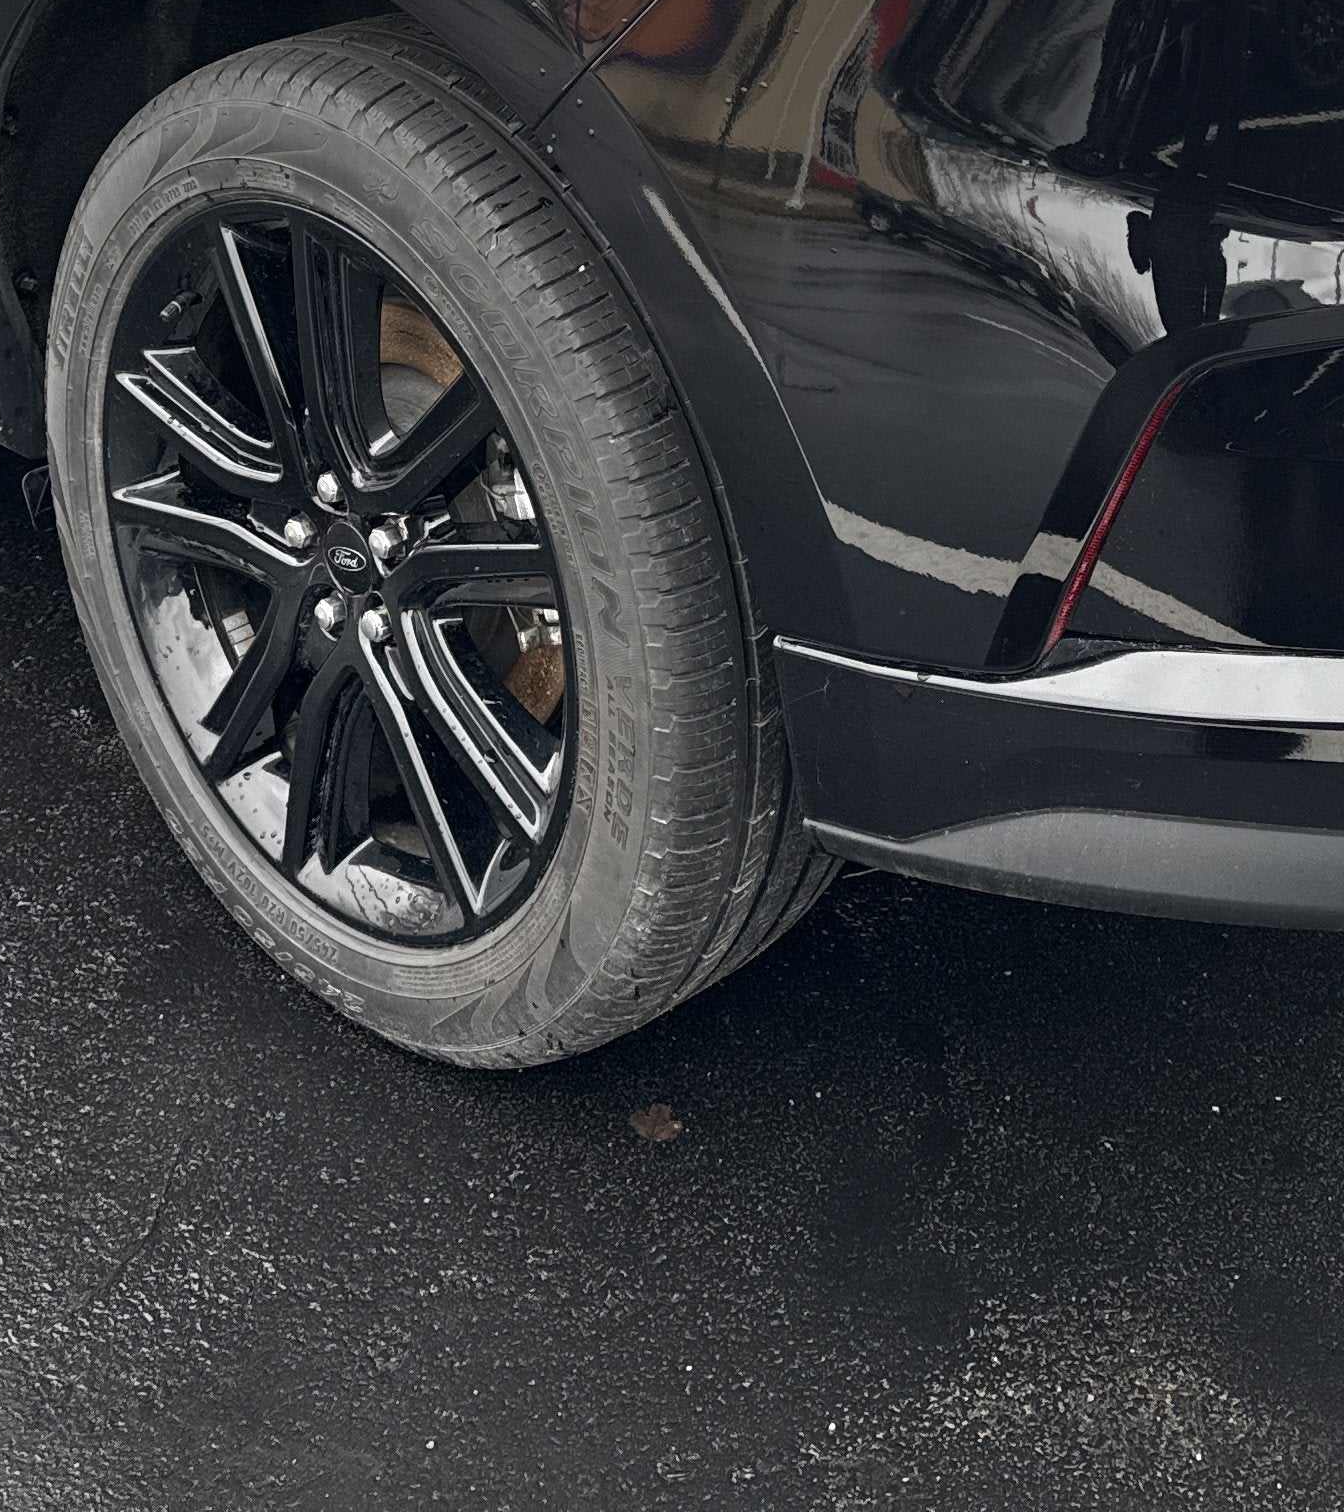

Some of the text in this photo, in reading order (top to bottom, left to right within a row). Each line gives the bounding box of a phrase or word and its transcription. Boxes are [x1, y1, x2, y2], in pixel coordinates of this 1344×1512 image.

[408, 216, 631, 649] SCORPION
[332, 548, 361, 569] Ford
[611, 675, 636, 851] VERDE
[227, 860, 257, 897] 102V
[260, 895, 288, 925] R20
[288, 919, 342, 965] 245/50
